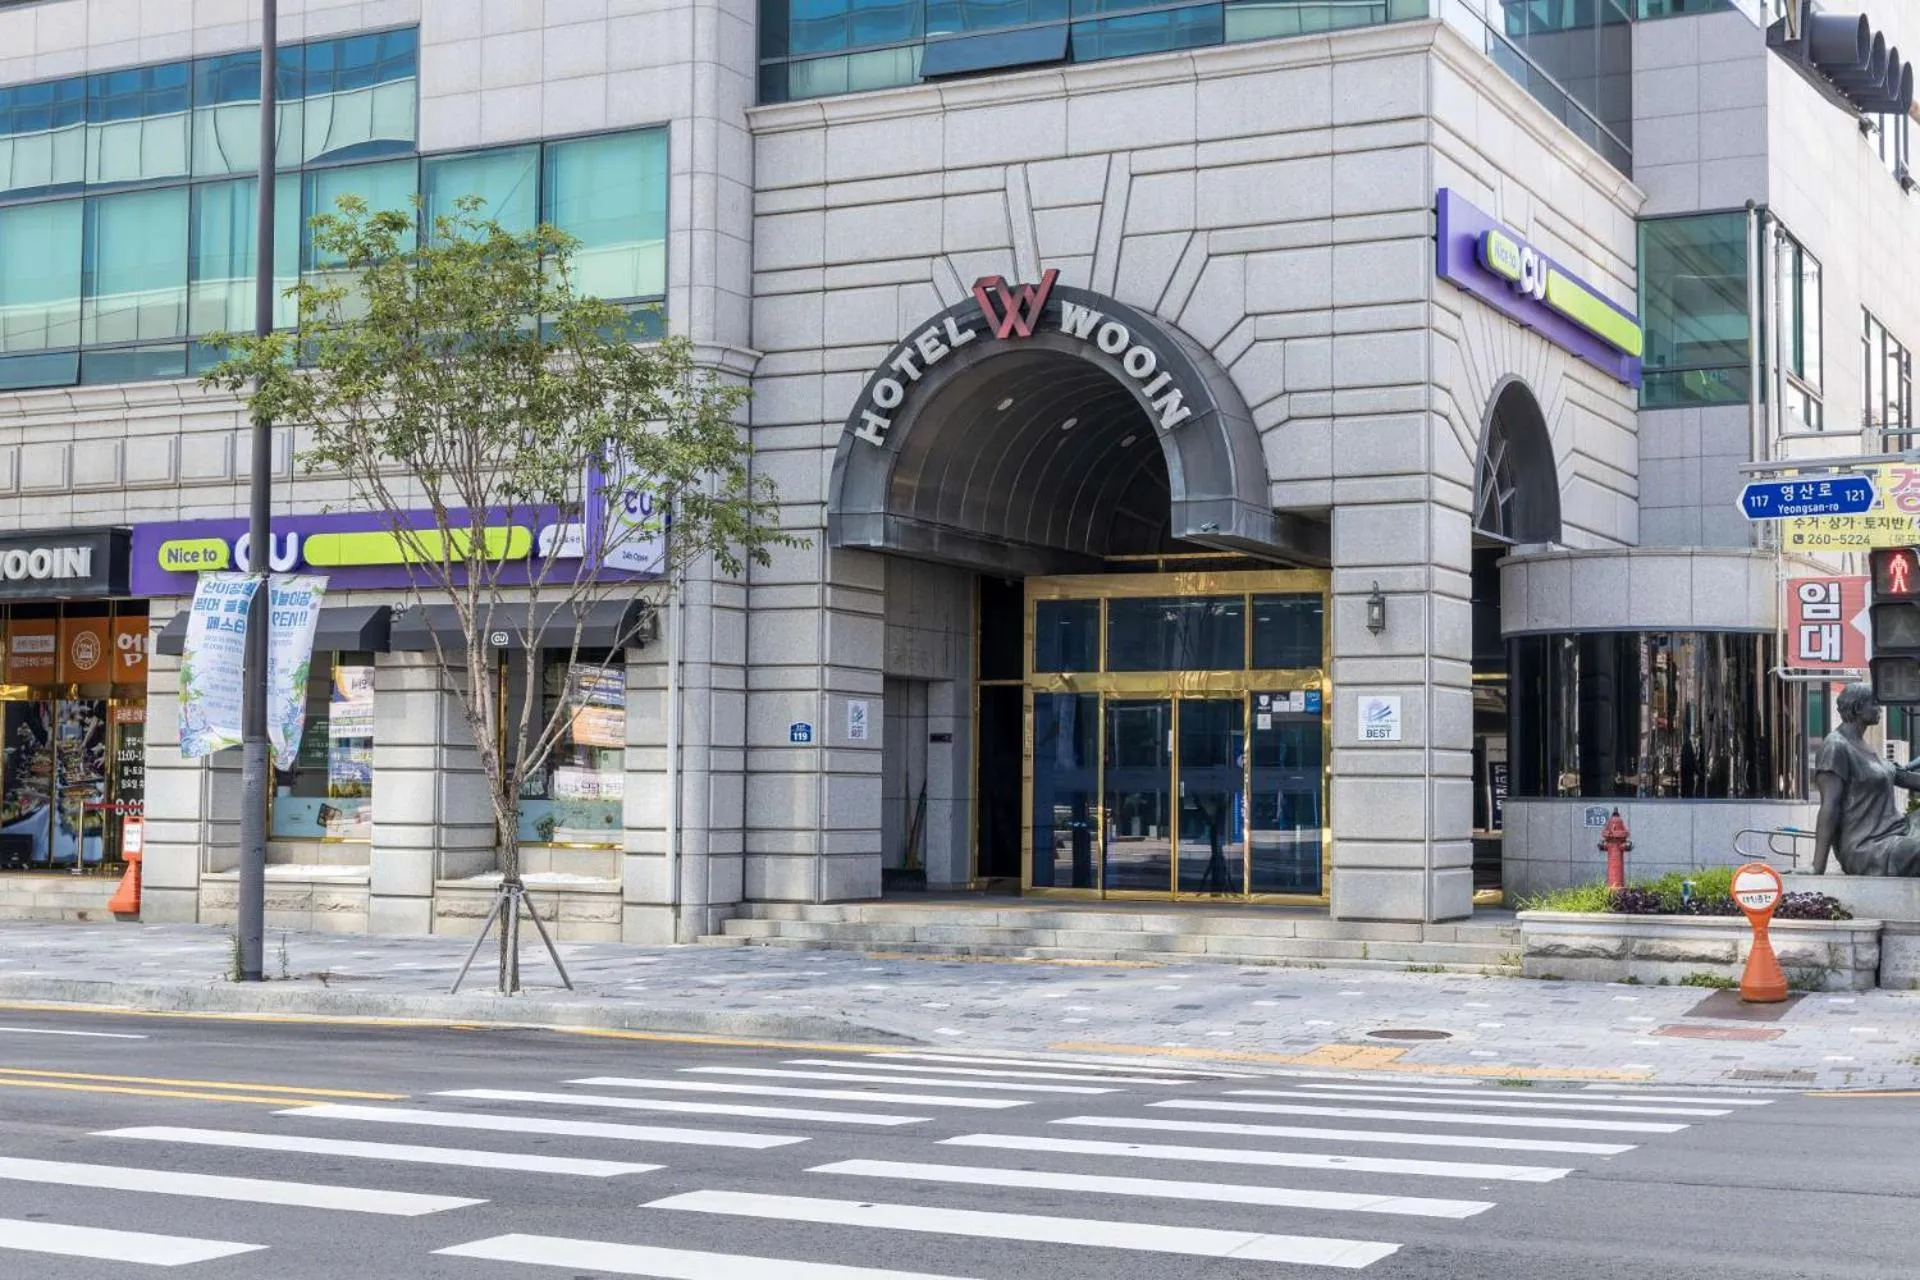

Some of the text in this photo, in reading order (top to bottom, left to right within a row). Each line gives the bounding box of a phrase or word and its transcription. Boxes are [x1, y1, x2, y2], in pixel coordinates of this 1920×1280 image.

[1521, 247, 1546, 300] CU
[855, 316, 976, 446] HOTEL
[1060, 301, 1192, 430] WOOIN
[625, 490, 653, 516] CU
[1751, 483, 1865, 508] 117 영산로 121
[1777, 502, 1839, 515] Yeongsan-ro
[0, 547, 92, 580] OOIN
[167, 547, 217, 564] Nice to
[1798, 582, 1842, 662] 임대
[117, 632, 148, 667] 엄
[793, 732, 808, 741] 119
[1366, 729, 1392, 738] BEST
[1590, 816, 1606, 825] 119
